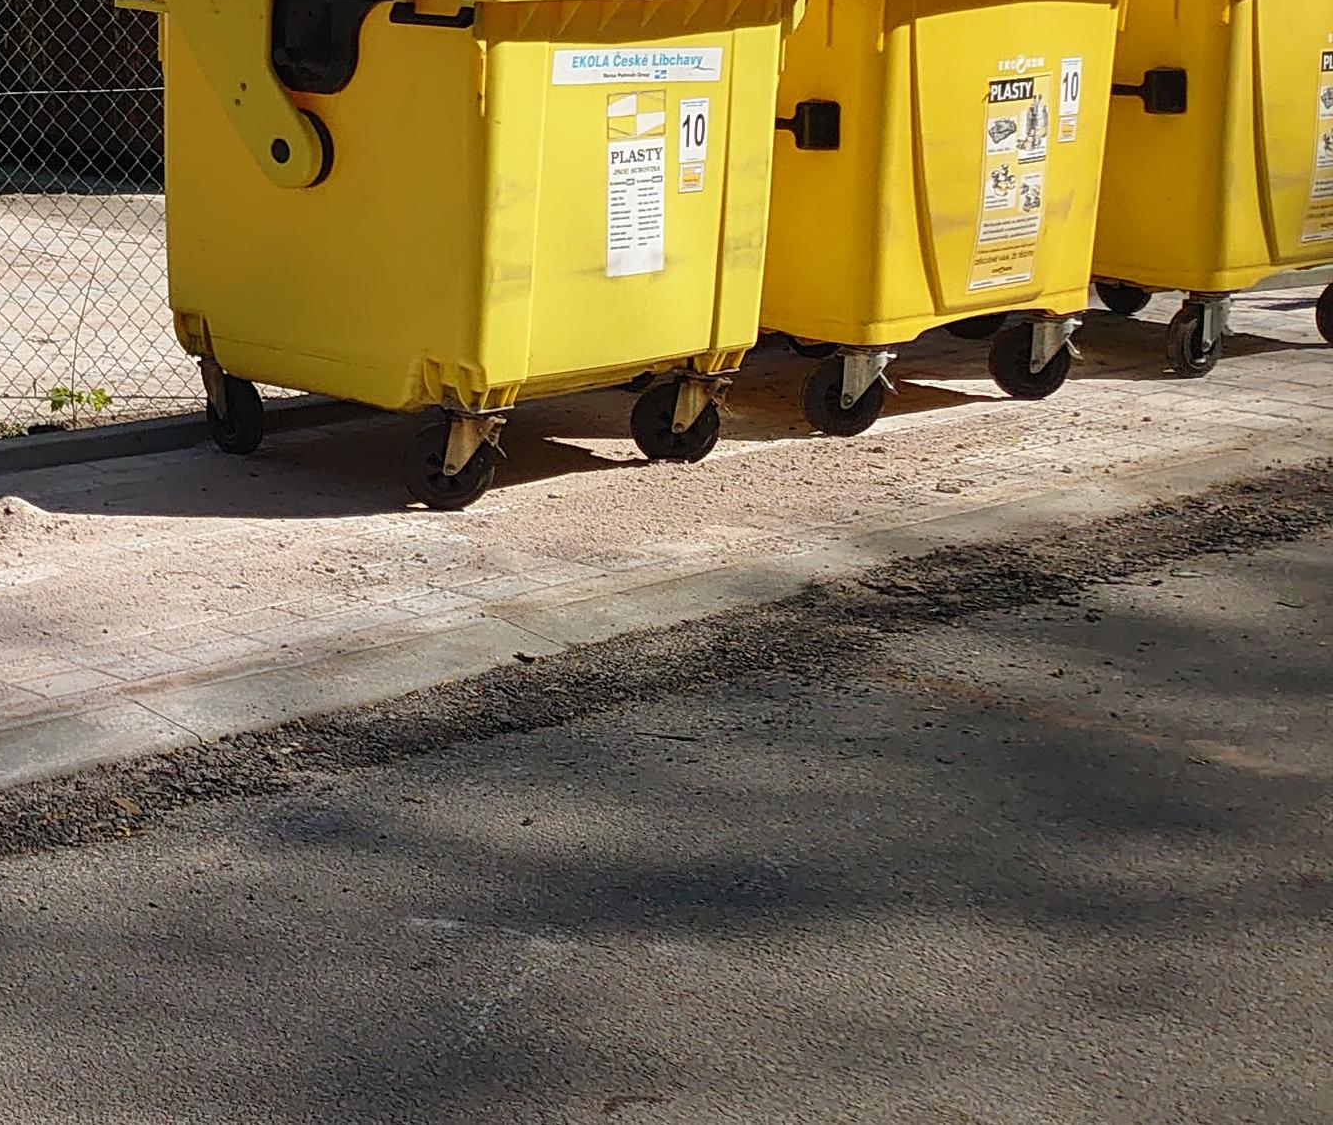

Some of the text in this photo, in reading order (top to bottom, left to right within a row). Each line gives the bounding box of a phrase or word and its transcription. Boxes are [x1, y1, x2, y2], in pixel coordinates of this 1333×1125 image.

[572, 52, 703, 69] EKOLA České Libchavy
[990, 81, 1032, 101] PLASTY
[1063, 71, 1079, 102] 10
[682, 113, 706, 147] 10
[610, 147, 663, 164] PLASTY
